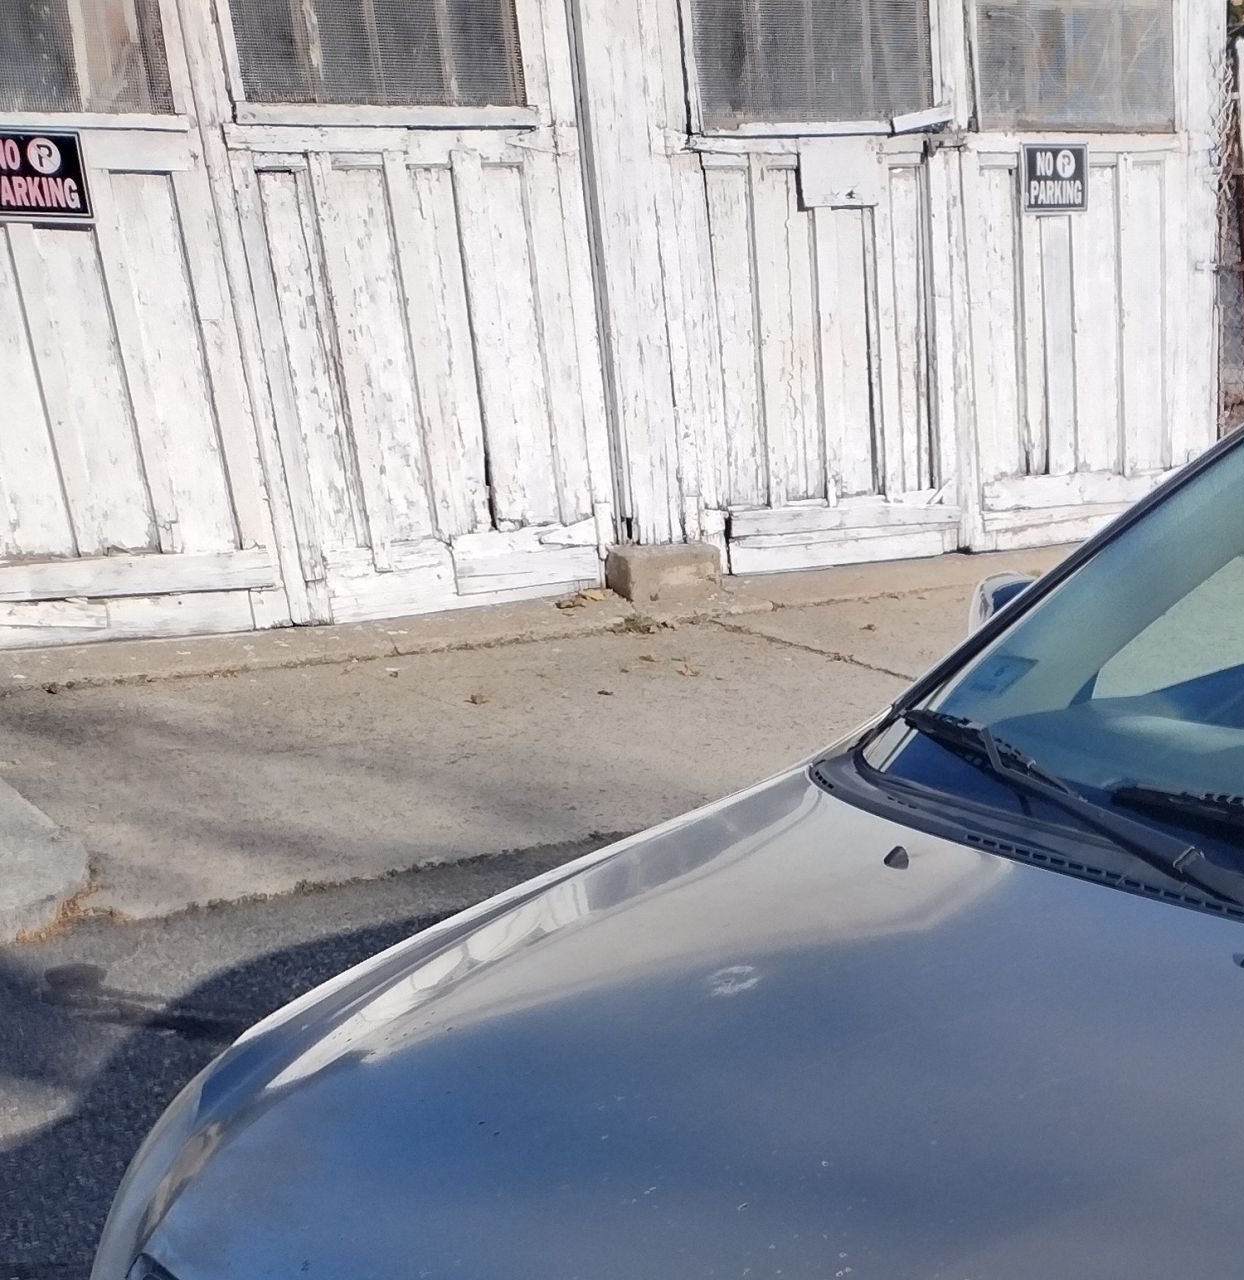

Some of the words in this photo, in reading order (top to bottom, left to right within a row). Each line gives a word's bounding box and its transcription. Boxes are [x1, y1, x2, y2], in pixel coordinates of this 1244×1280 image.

[1036, 151, 1053, 176] NO
[1, 175, 80, 209] ARKING
[1030, 180, 1082, 205] PARKING
